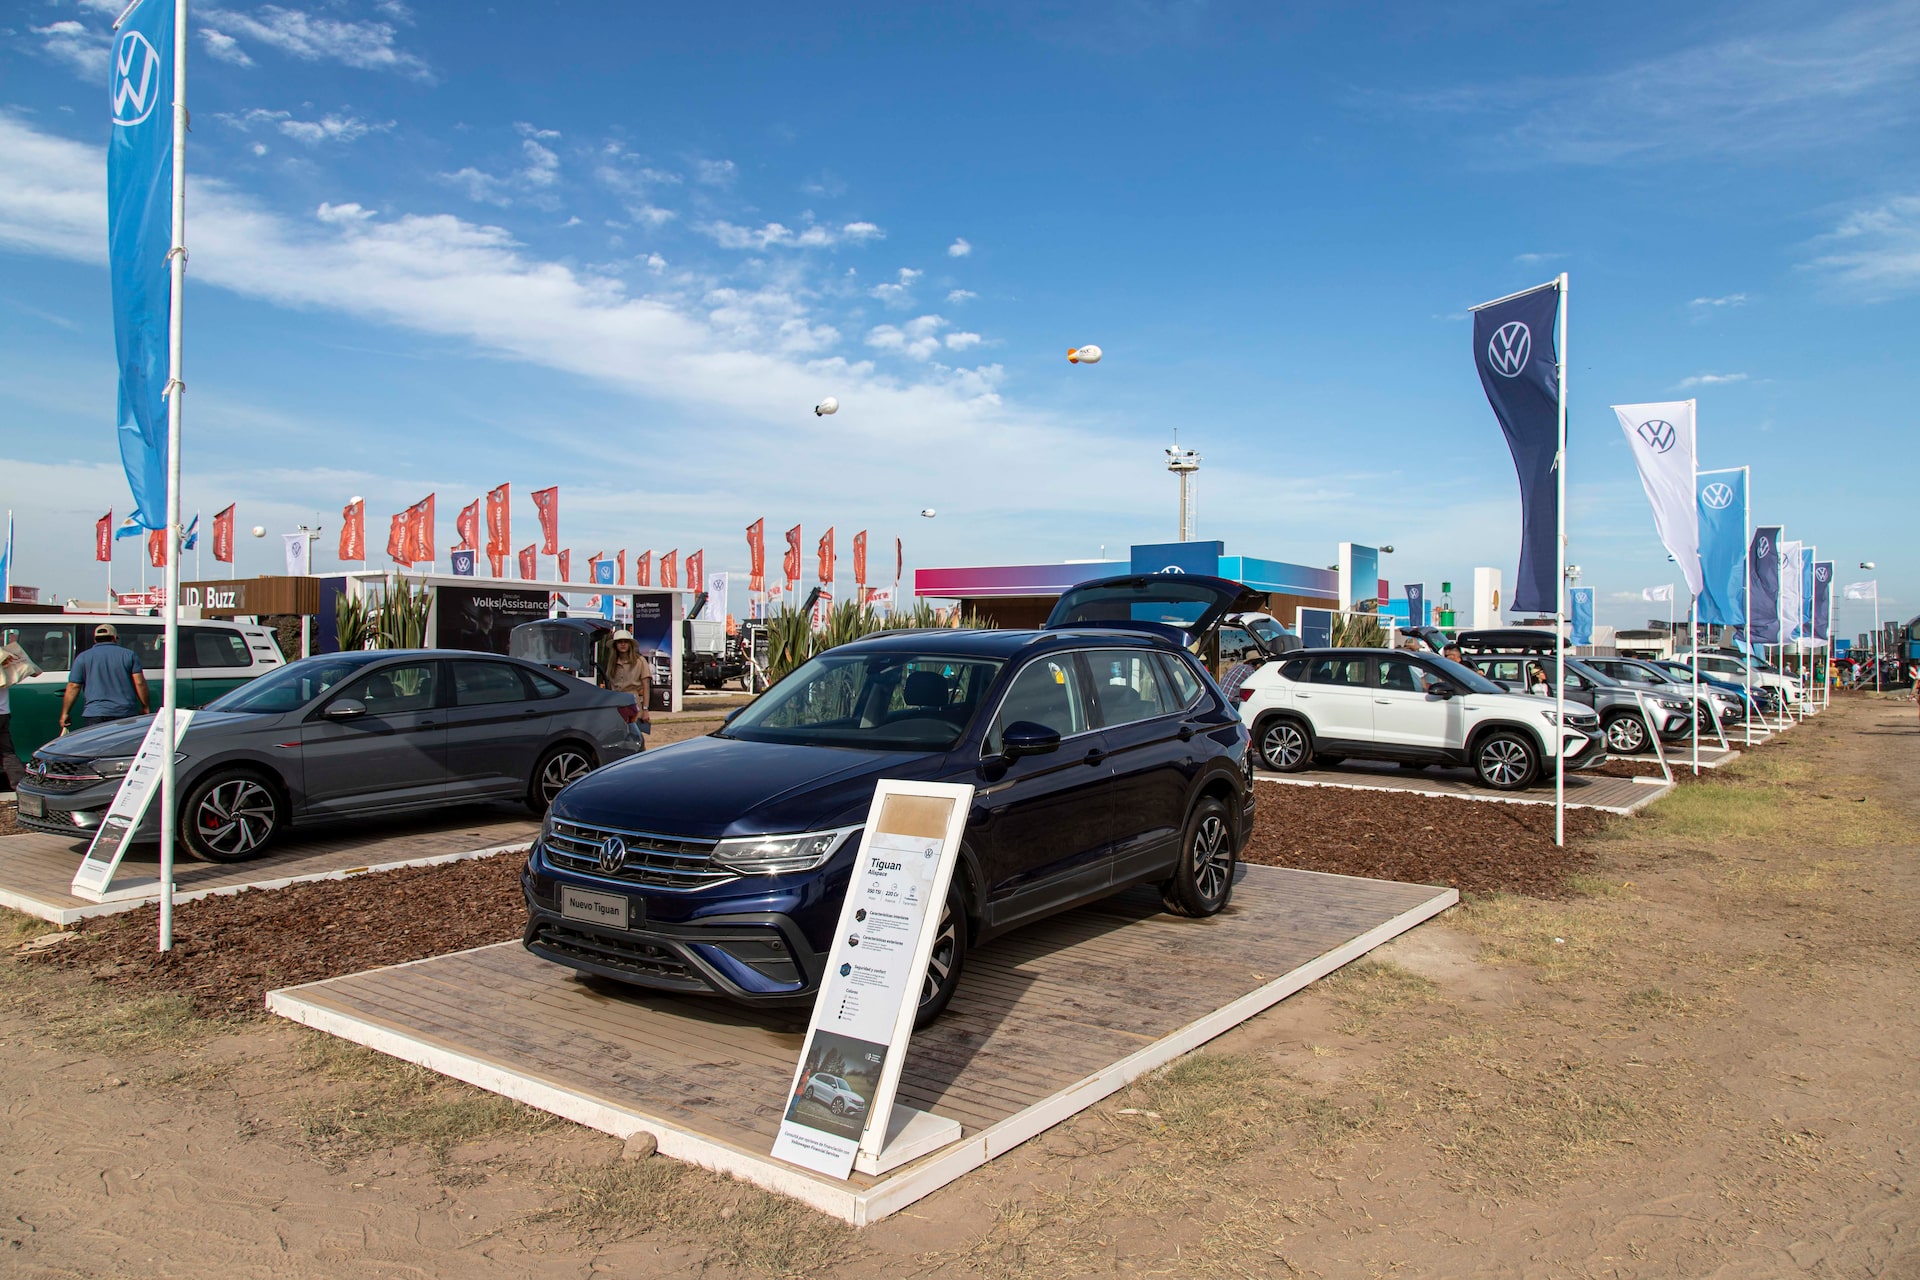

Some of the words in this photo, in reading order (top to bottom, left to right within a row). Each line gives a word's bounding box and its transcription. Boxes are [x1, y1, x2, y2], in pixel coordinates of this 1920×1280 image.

[206, 586, 236, 609] Buzz
[871, 858, 902, 871] Tiguan
[570, 897, 593, 911] Nuevo
[594, 901, 620, 916] Tiguan
